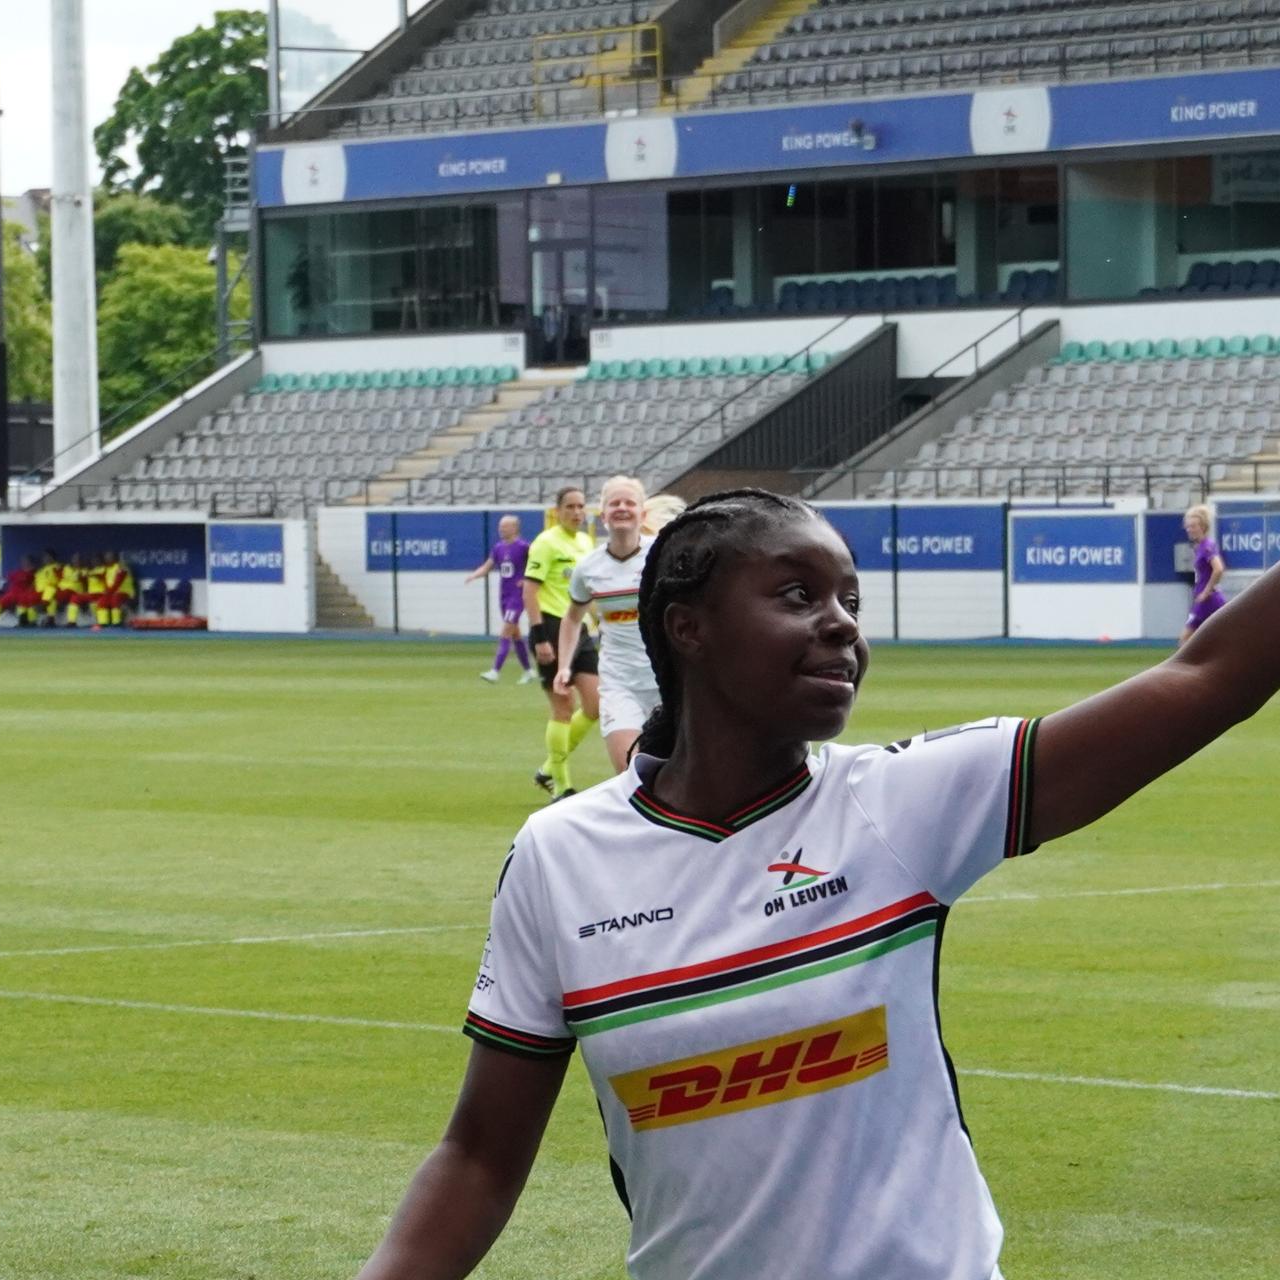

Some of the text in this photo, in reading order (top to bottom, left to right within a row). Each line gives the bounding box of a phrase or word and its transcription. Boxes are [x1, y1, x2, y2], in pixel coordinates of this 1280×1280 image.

[1171, 101, 1257, 122] KING POWER
[782, 131, 857, 151] KING POWE
[438, 158, 508, 177] KING POWER
[403, 539, 448, 555] POWER
[881, 536, 974, 554] KNG POWER
[1222, 532, 1262, 552] KING
[210, 551, 282, 569] KING POWER
[1026, 546, 1122, 566] KING POWER
[764, 876, 849, 918] OH LEUVEN
[578, 907, 674, 939] STANNO
[648, 1030, 858, 1117] DHL
